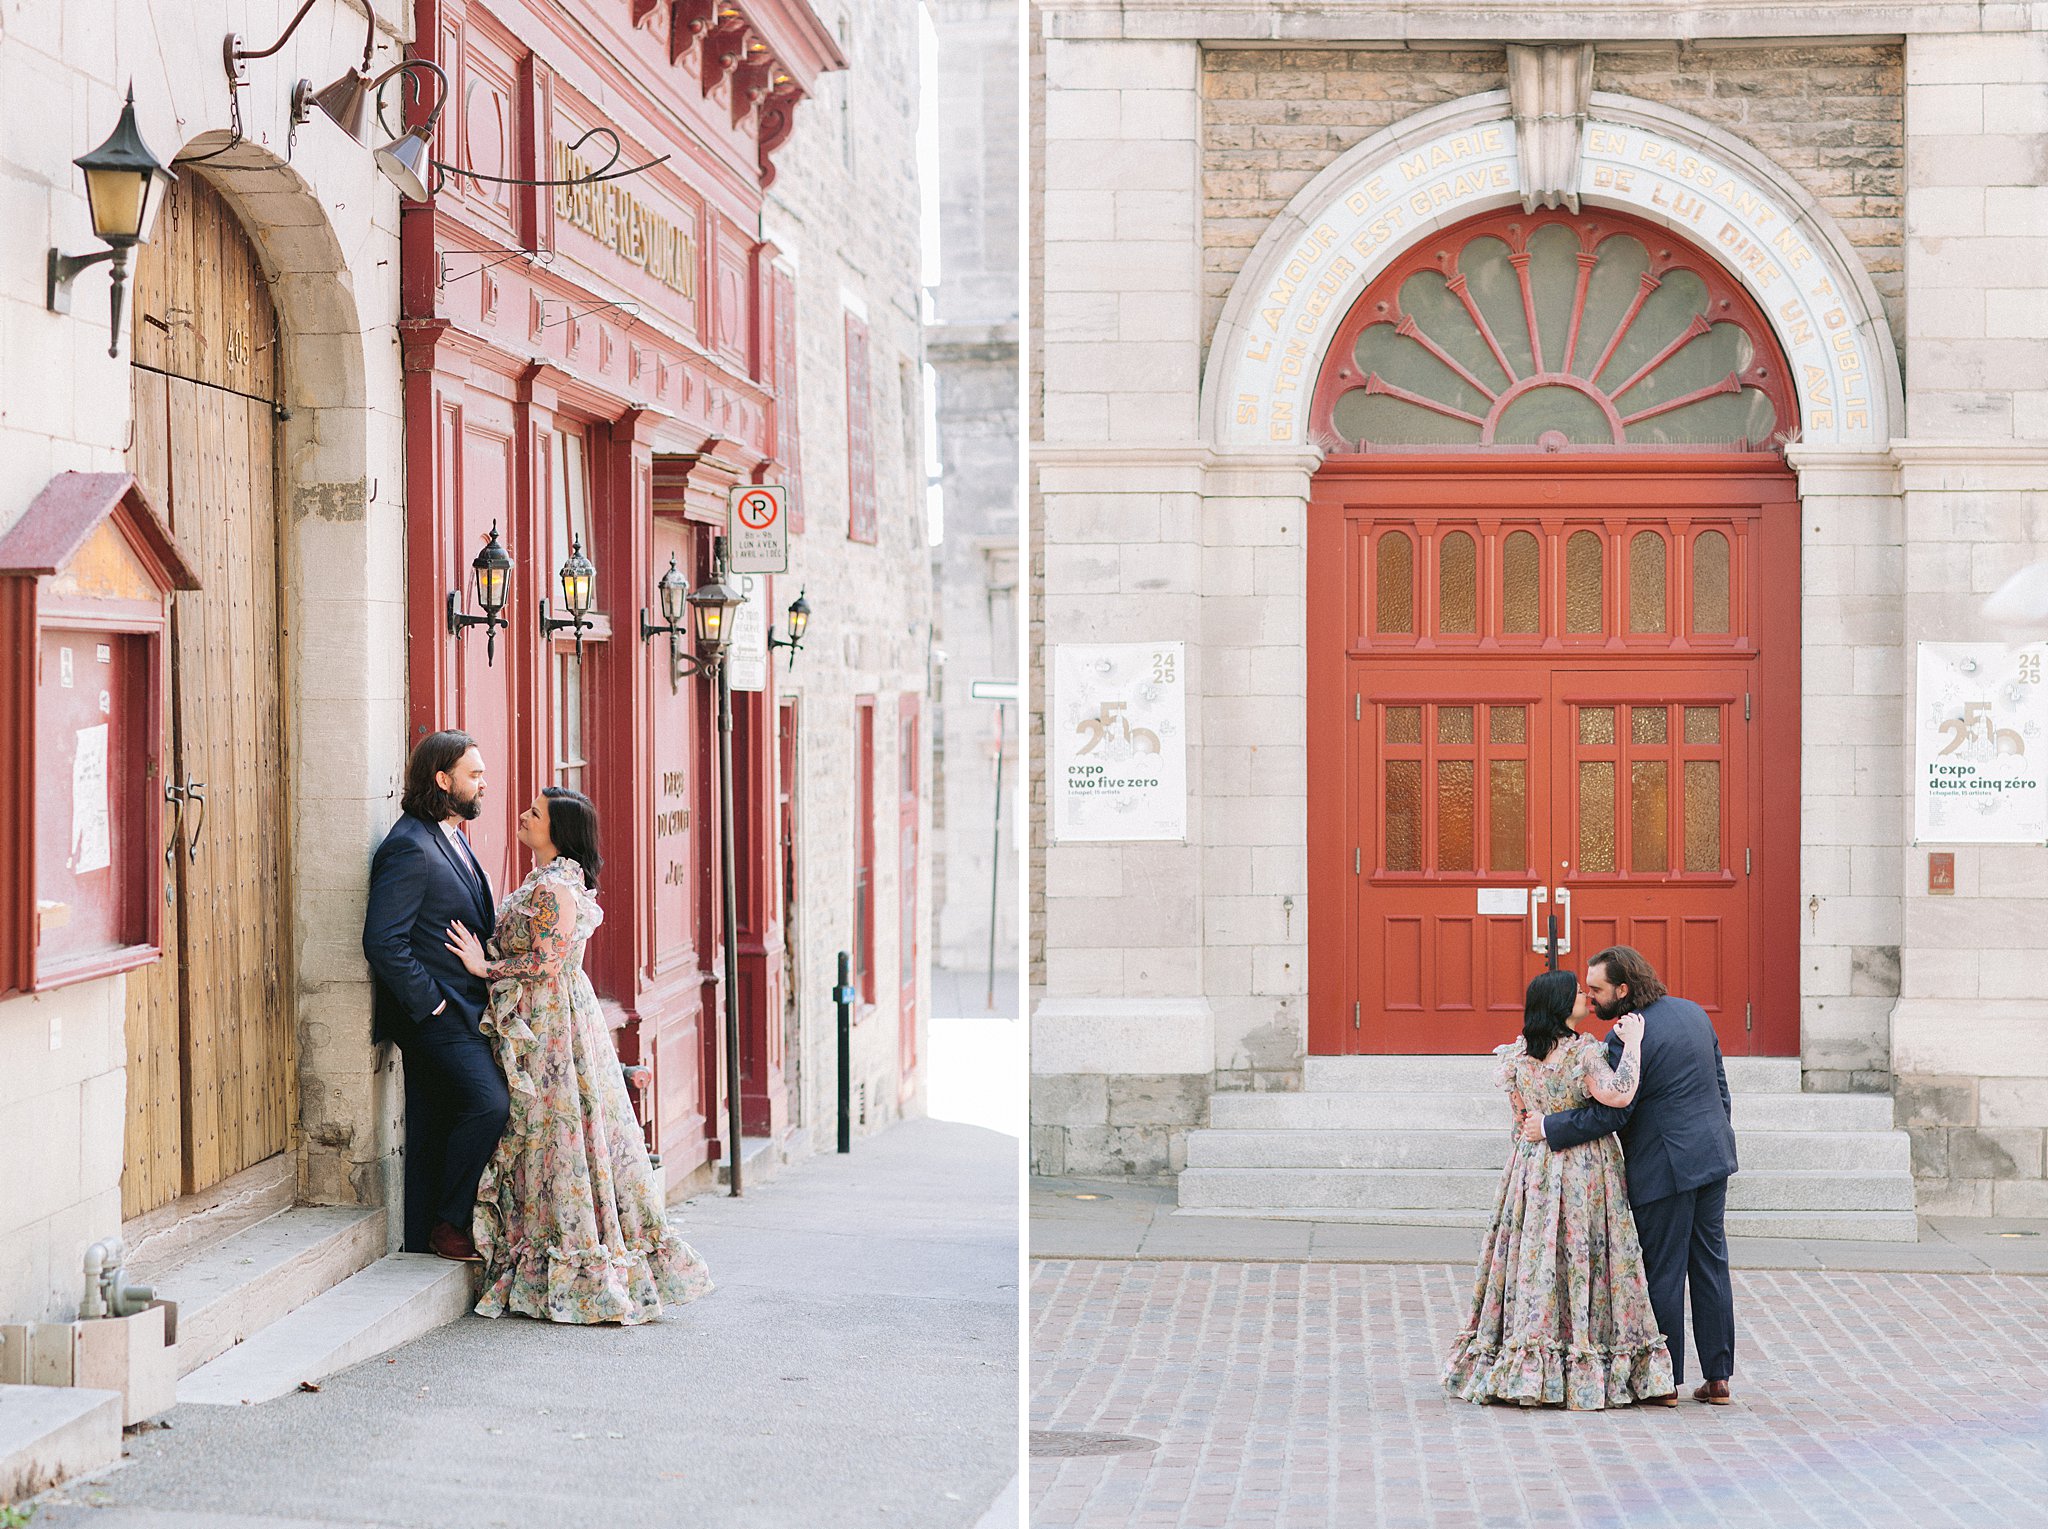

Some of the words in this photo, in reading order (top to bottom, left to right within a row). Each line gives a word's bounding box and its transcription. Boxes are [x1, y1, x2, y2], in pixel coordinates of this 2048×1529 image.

[1399, 128, 1504, 182] MARIE
[1345, 176, 1392, 217] DE
[1410, 165, 1510, 215] GRAVE
[1588, 128, 1627, 156] EN
[1640, 141, 1776, 226] PASSANT
[1773, 227, 1813, 271] NE
[1351, 206, 1403, 258] EST
[1246, 223, 1339, 363] L'AMOUR
[1594, 165, 1636, 193] DE
[1651, 182, 1706, 224] LUI
[1718, 221, 1782, 289] DIRE
[1779, 299, 1814, 346] UN
[1803, 364, 1834, 430] AVE
[1275, 338, 1308, 396] TON
[1236, 393, 1259, 425] SI
[1270, 402, 1293, 441] EN
[752, 499, 766, 520] P
[1152, 653, 1175, 668] 24
[1153, 669, 1175, 684] 25
[2018, 654, 2041, 669] 24
[2018, 669, 2041, 684] 25
[1068, 765, 1104, 777] expo
[1068, 778, 1095, 788] two
[1098, 776, 1125, 788] five
[1127, 779, 1159, 787] zero
[1929, 763, 1976, 778] l'expo
[1929, 778, 1967, 789] deux
[1969, 777, 2002, 792] cinq
[2004, 776, 2037, 789] zéro
